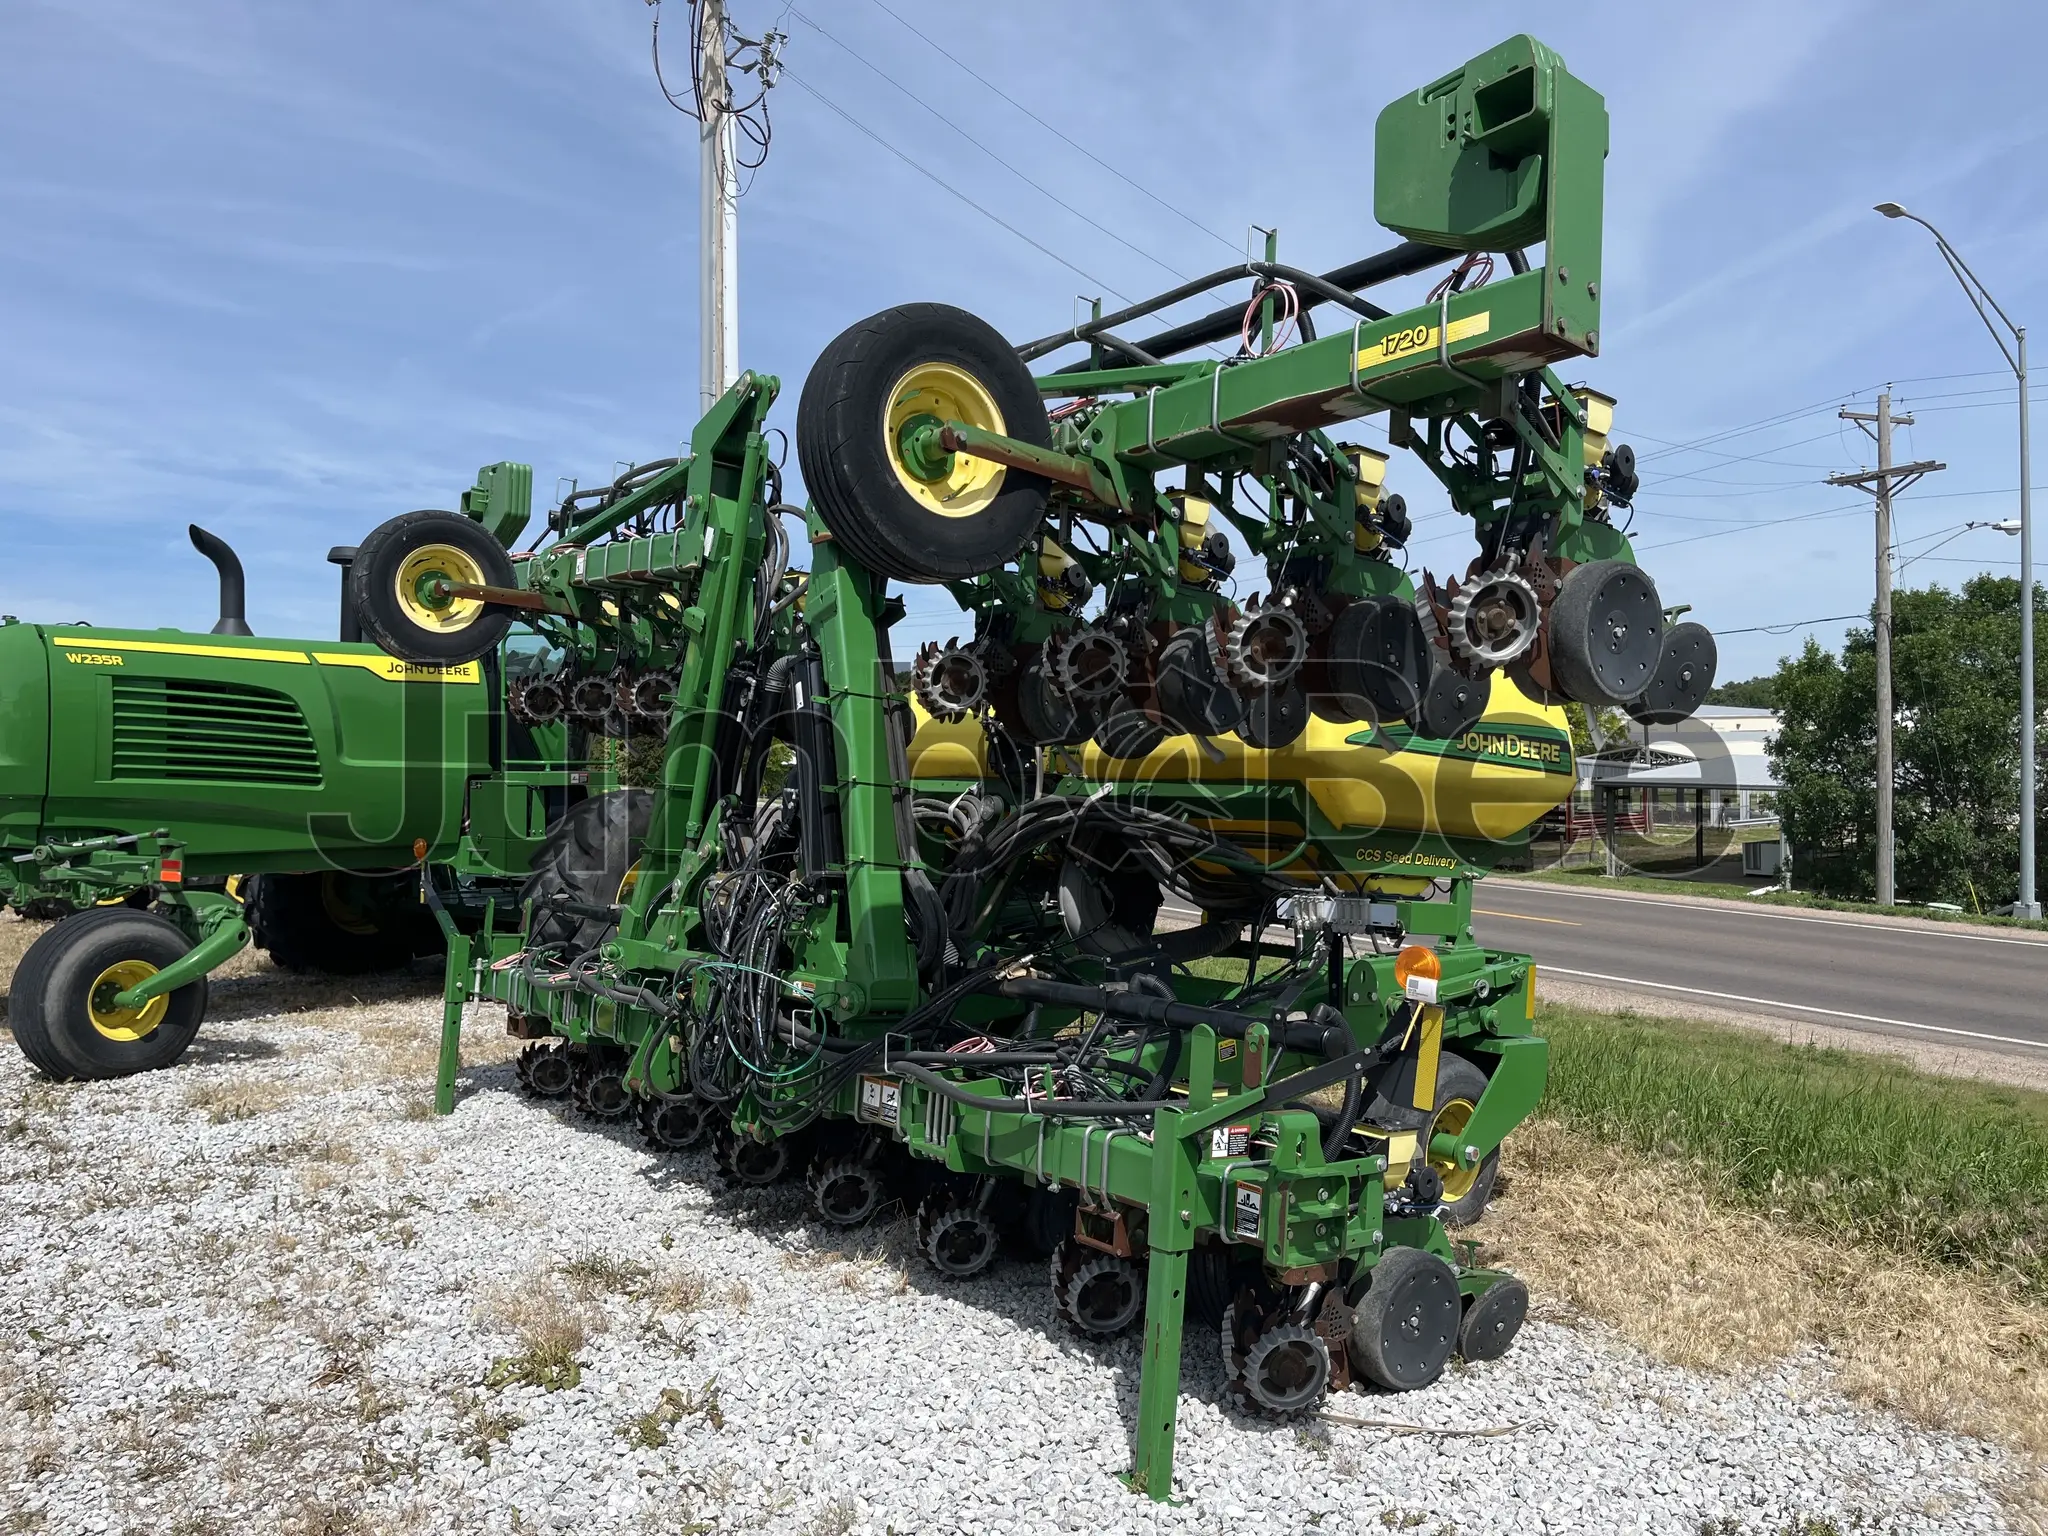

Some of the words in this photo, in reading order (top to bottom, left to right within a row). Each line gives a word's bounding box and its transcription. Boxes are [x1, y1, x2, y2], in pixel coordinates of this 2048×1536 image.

[1380, 325, 1428, 355] 1720
[65, 652, 124, 666] W235R
[387, 662, 424, 675] JOHN
[427, 665, 471, 676] DEERE
[1456, 732, 1505, 755] JOHN
[1506, 734, 1561, 763] DEERE
[1356, 848, 1382, 862] CCS
[1384, 850, 1412, 864] Seed
[1415, 853, 1457, 870] Delivery
